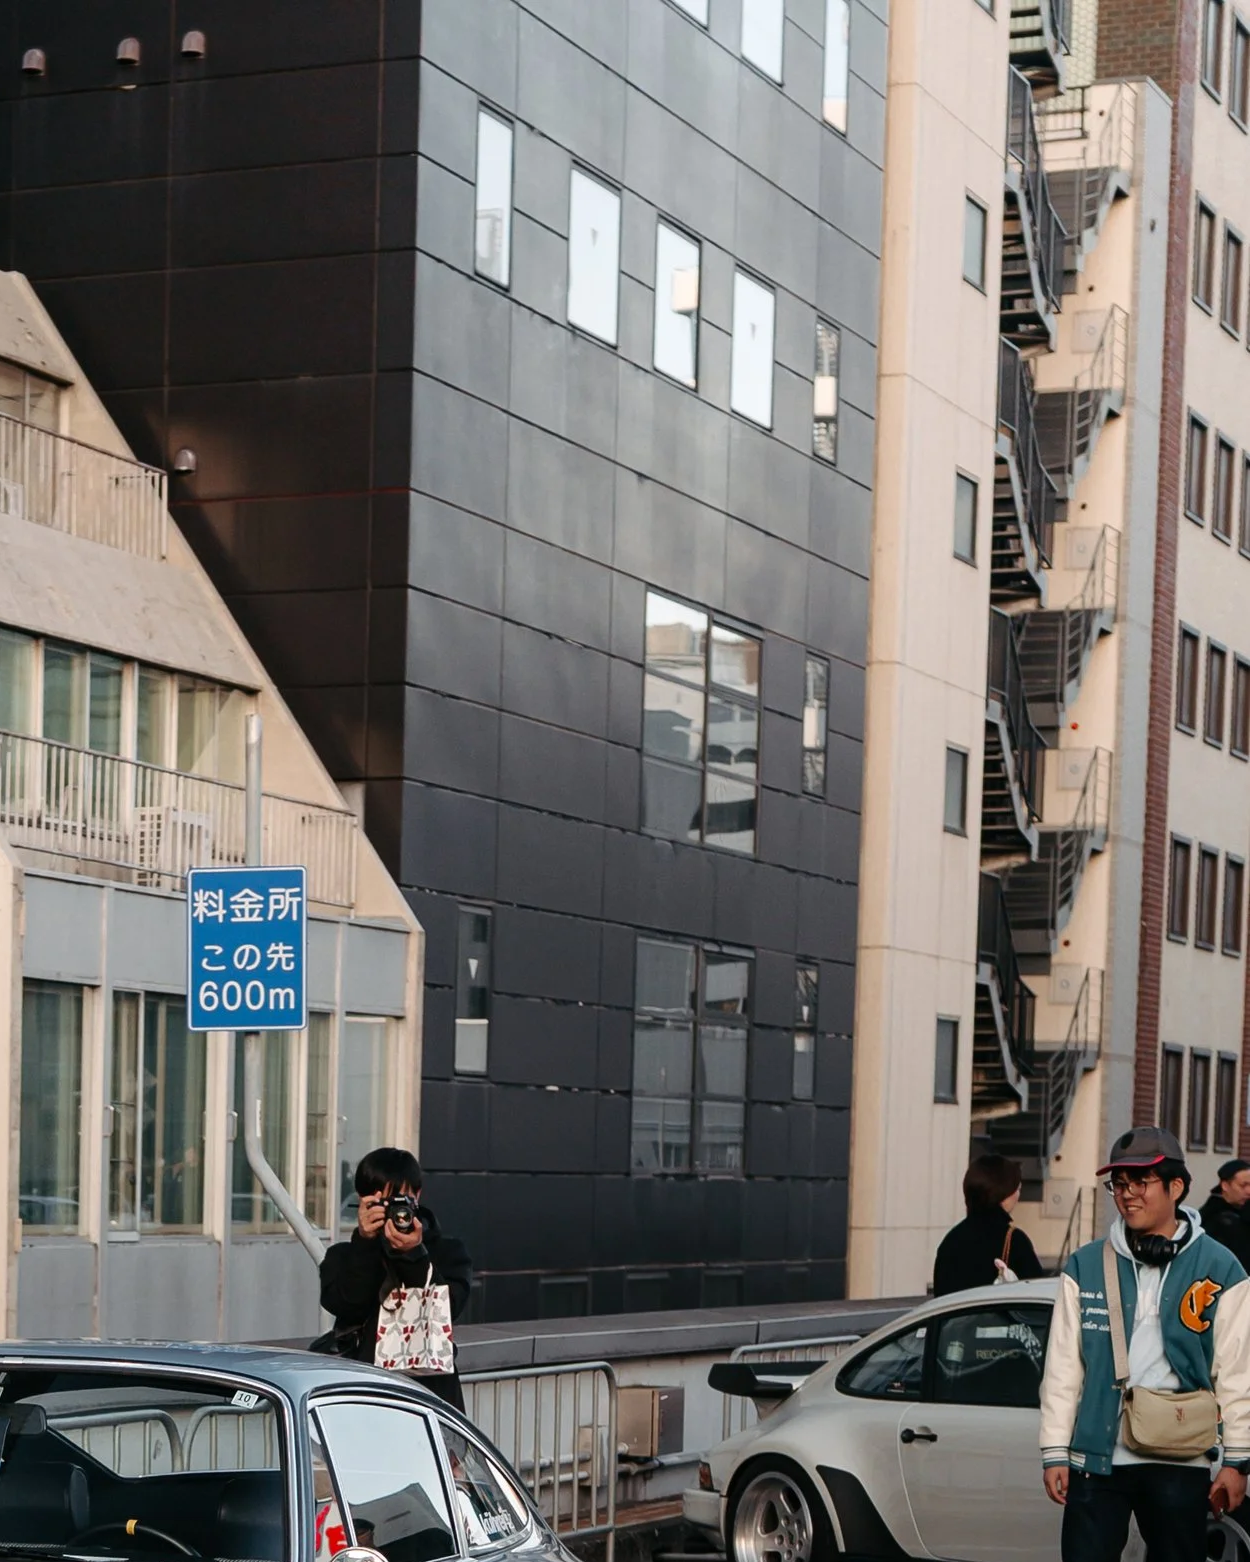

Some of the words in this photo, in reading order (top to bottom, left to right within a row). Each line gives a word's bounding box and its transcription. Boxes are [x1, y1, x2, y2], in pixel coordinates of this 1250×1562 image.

[193, 886, 302, 924] 料金所
[201, 942, 295, 972] この先
[199, 980, 296, 1012] 600m
